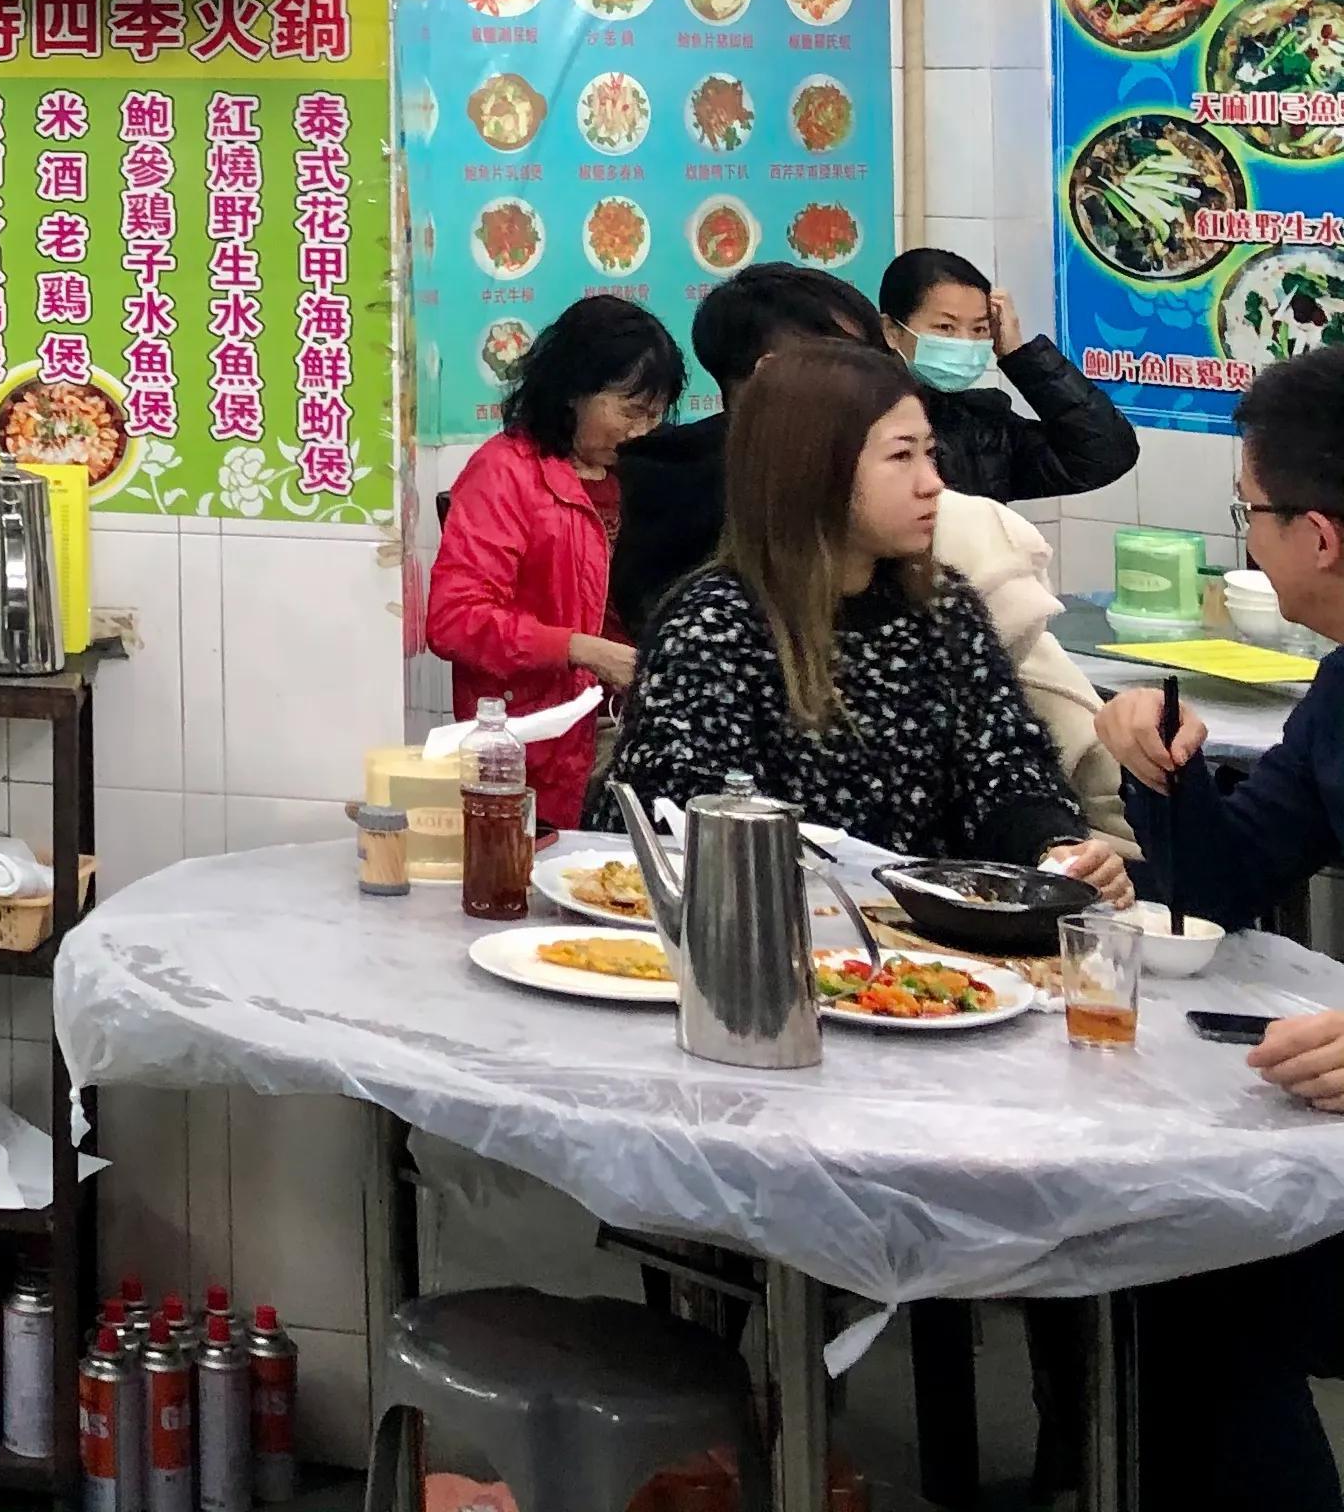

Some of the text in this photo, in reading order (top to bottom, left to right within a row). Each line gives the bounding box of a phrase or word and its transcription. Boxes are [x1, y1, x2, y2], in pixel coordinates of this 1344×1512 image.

[210, 94, 261, 439] 紅燒野生水魚煲
[298, 95, 349, 492] 泰式花甲海鮮蚧煲
